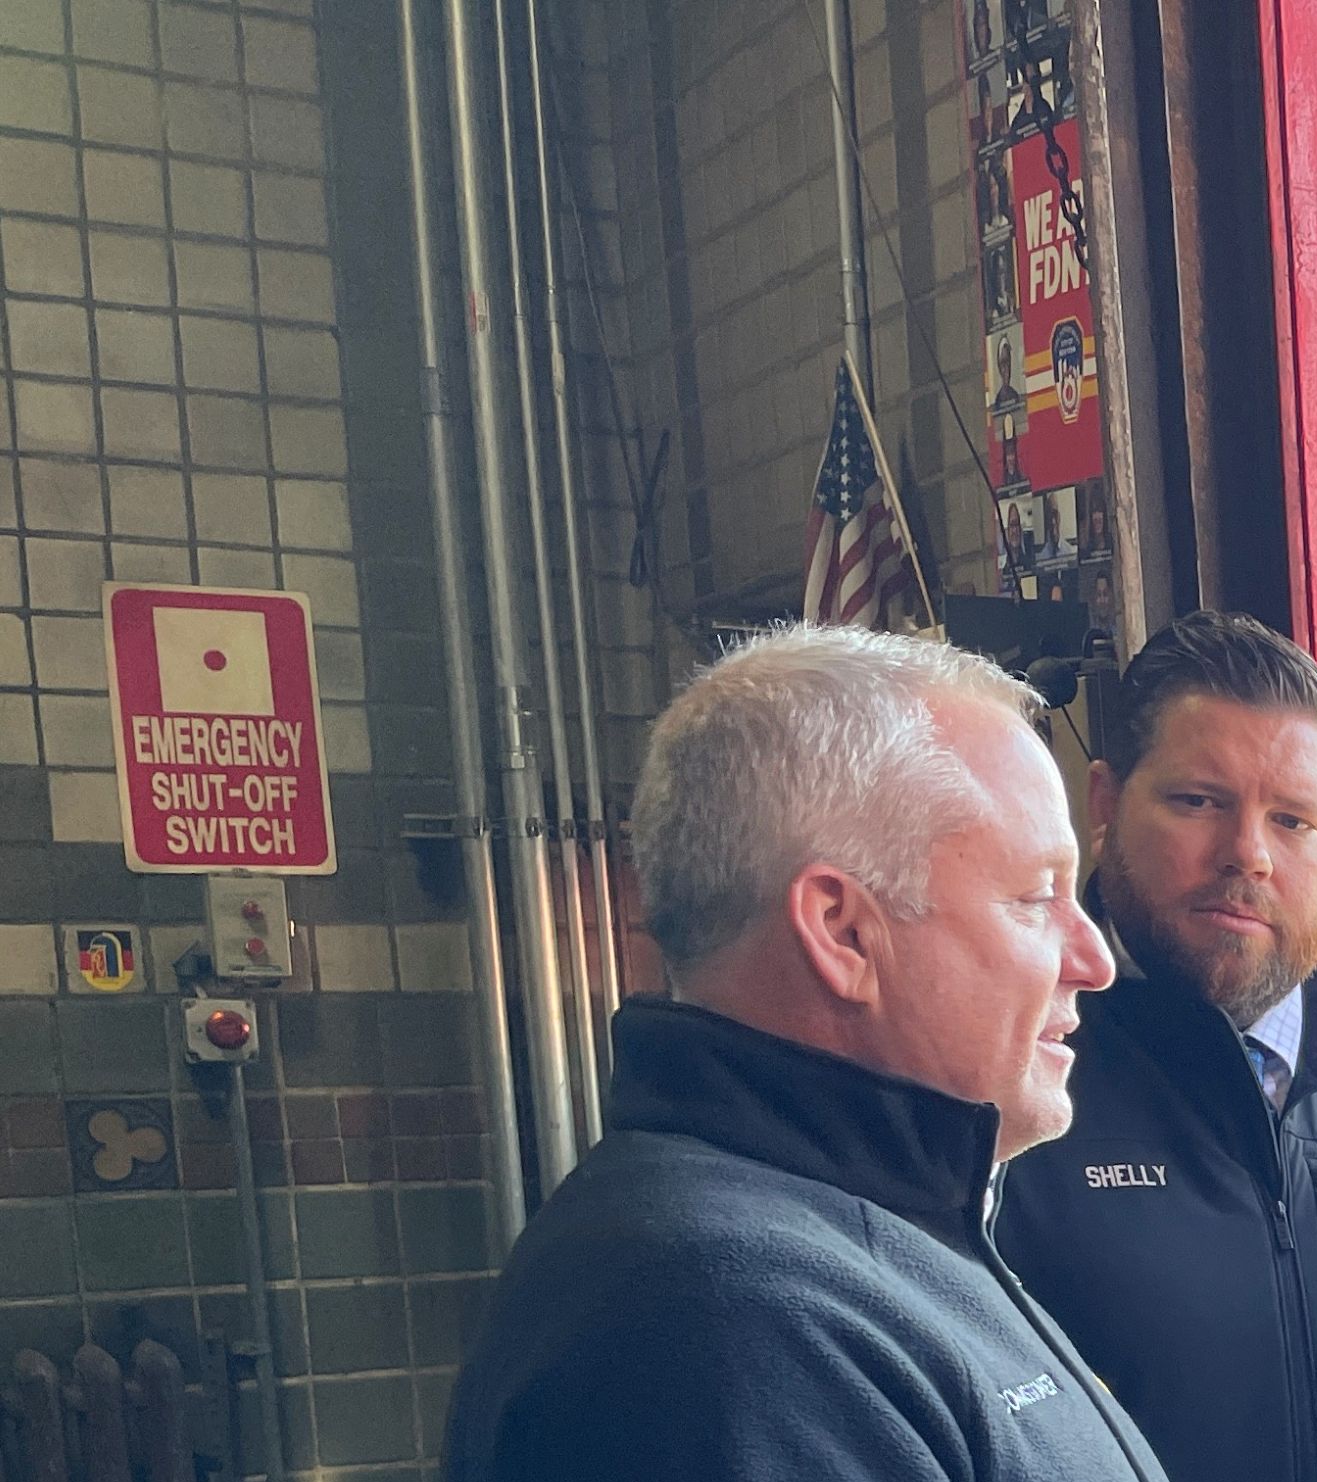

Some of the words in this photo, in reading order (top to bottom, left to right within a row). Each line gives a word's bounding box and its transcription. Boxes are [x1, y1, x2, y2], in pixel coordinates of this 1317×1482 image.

[1023, 189, 1053, 251] WE
[1029, 239, 1091, 305] FDN
[132, 716, 303, 768] EMERGENCY
[152, 772, 298, 812] SHUT-OFF
[166, 814, 296, 855] SWITCH
[1084, 1163, 1168, 1189] SHELLY
